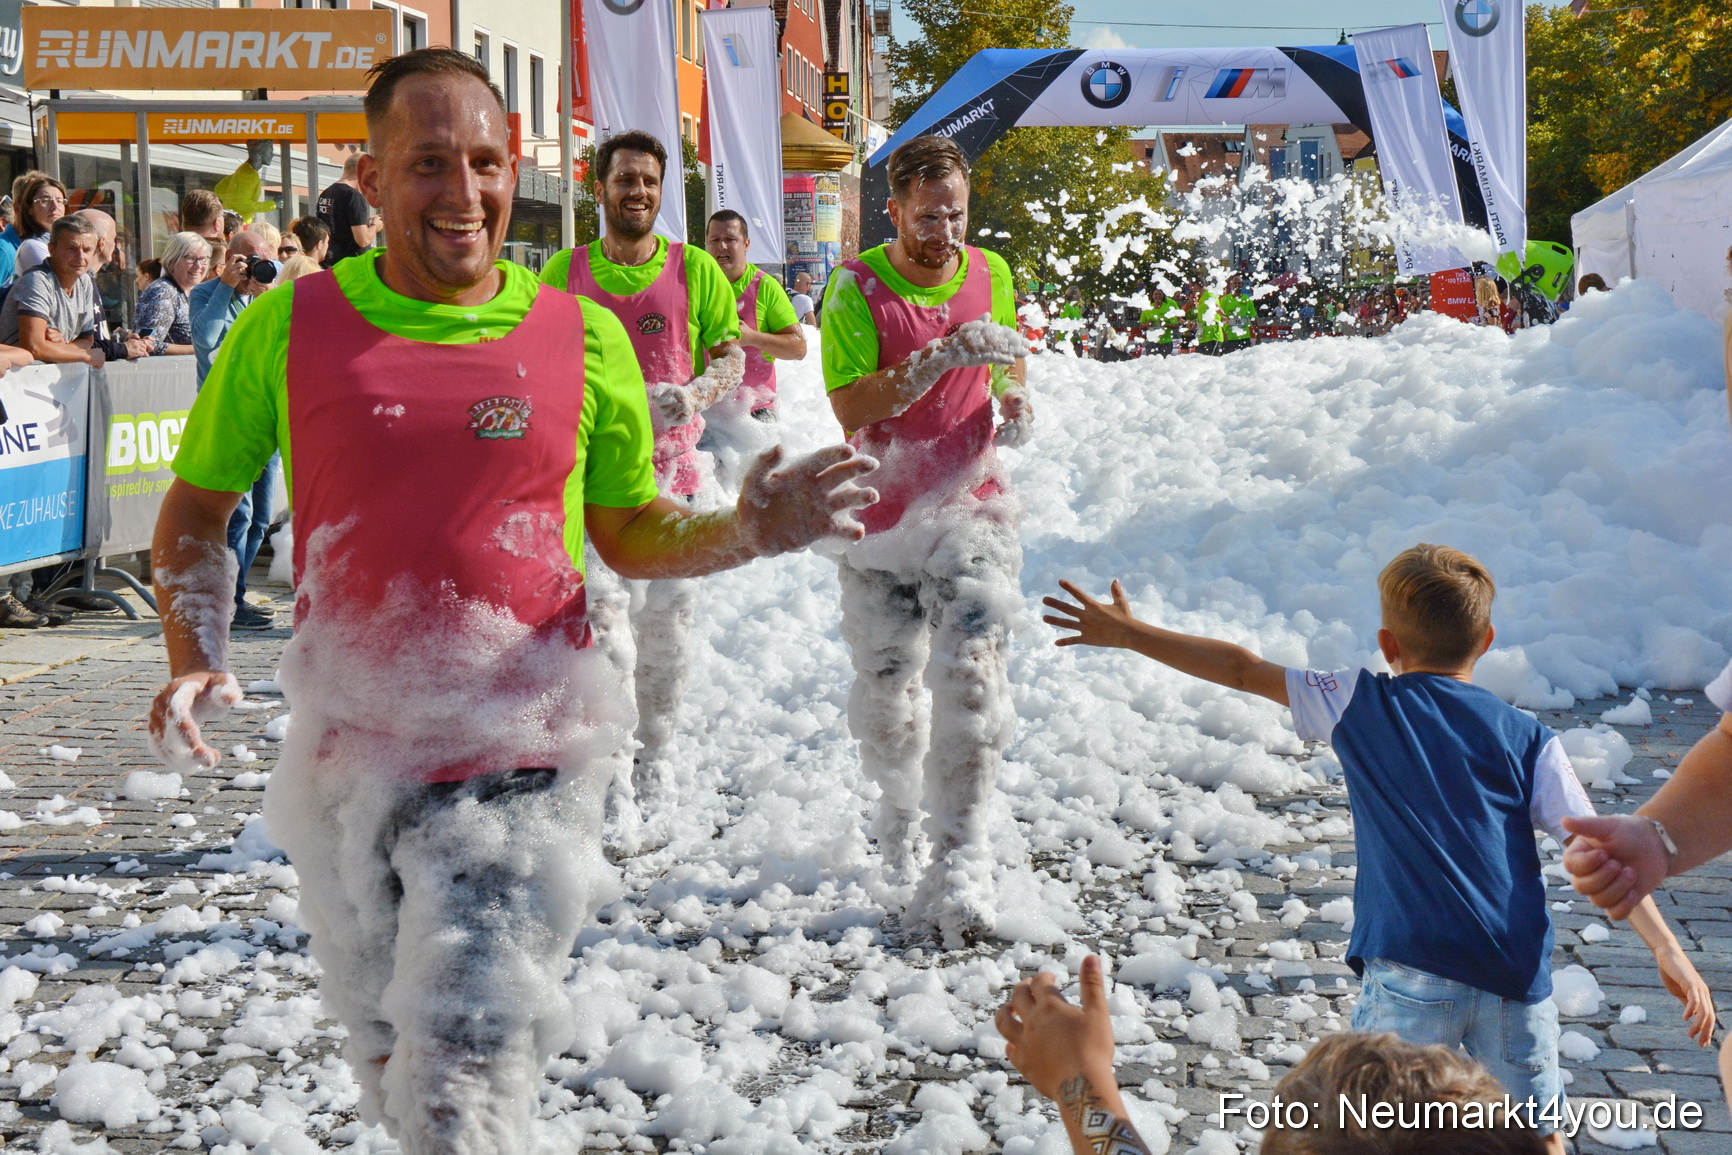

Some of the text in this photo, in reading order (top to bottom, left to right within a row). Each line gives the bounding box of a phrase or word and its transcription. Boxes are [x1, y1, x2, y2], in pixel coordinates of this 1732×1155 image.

[163, 119, 294, 134] RUNMARKT.DE
[1447, 297, 1466, 305] BMW
[0, 422, 41, 456] NE
[142, 476, 155, 497] by
[16, 490, 77, 531] ZUHAUSE
